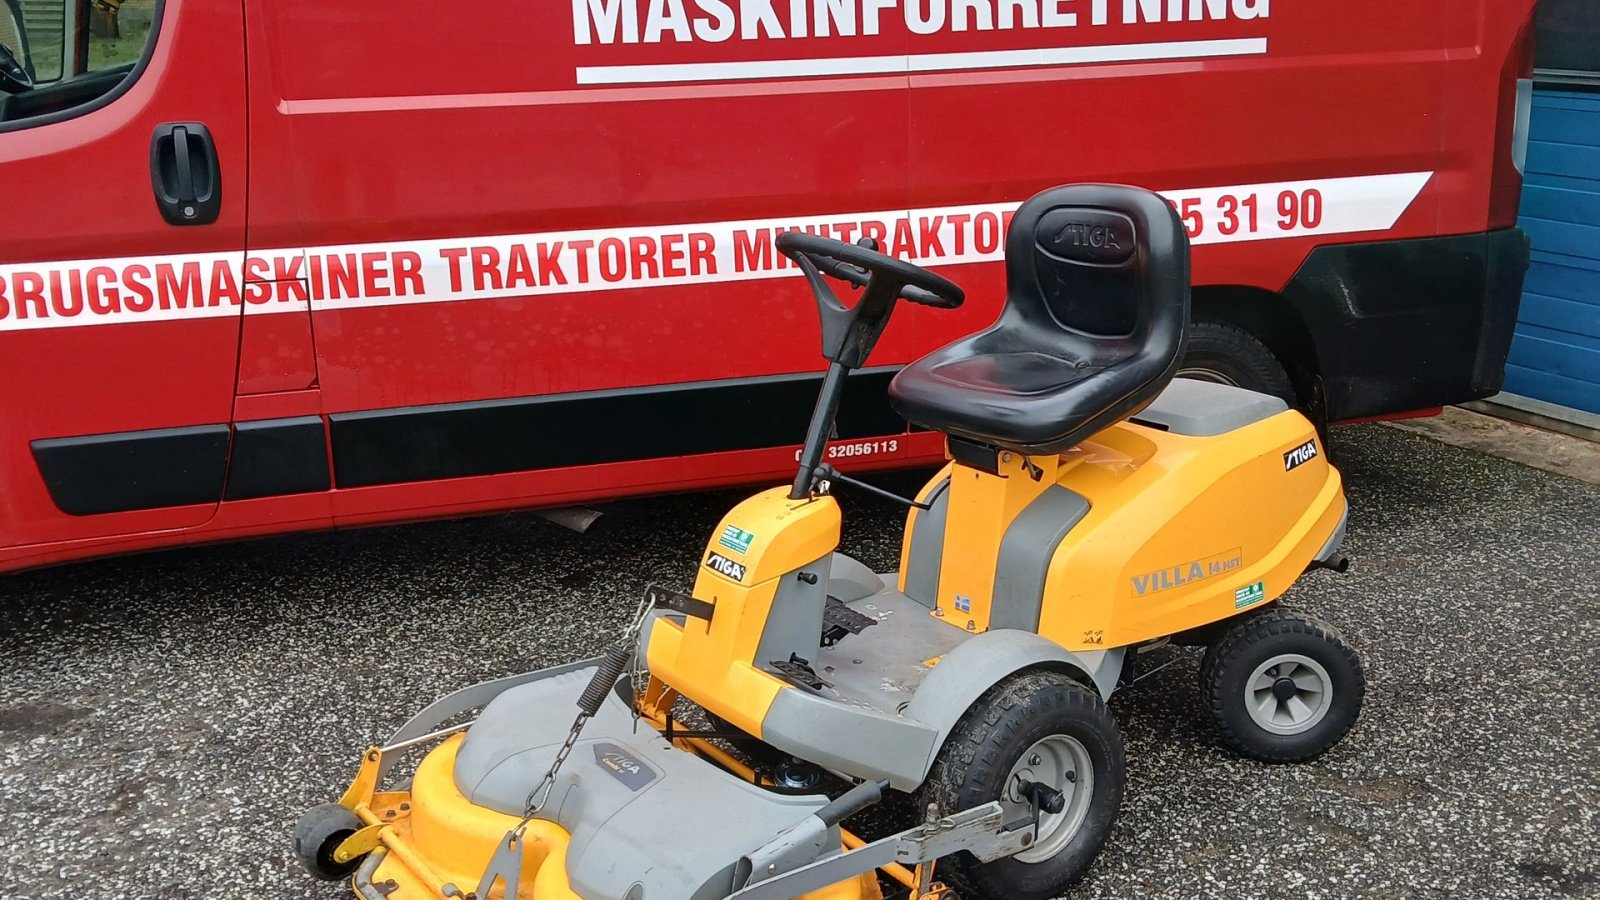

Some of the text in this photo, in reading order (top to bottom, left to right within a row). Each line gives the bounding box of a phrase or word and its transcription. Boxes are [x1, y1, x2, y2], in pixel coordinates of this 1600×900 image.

[572, 0, 1270, 45] MASKINFOR
[1053, 221, 1121, 250] STIGA
[0, 188, 1323, 320] RUGSMASKINER TRAKTORER MITRAKTO 5 31 90
[828, 440, 898, 459] 32056113
[1286, 442, 1316, 470] STIGA
[706, 554, 744, 580] STIGA
[1132, 557, 1241, 595] VILLA 14 HST
